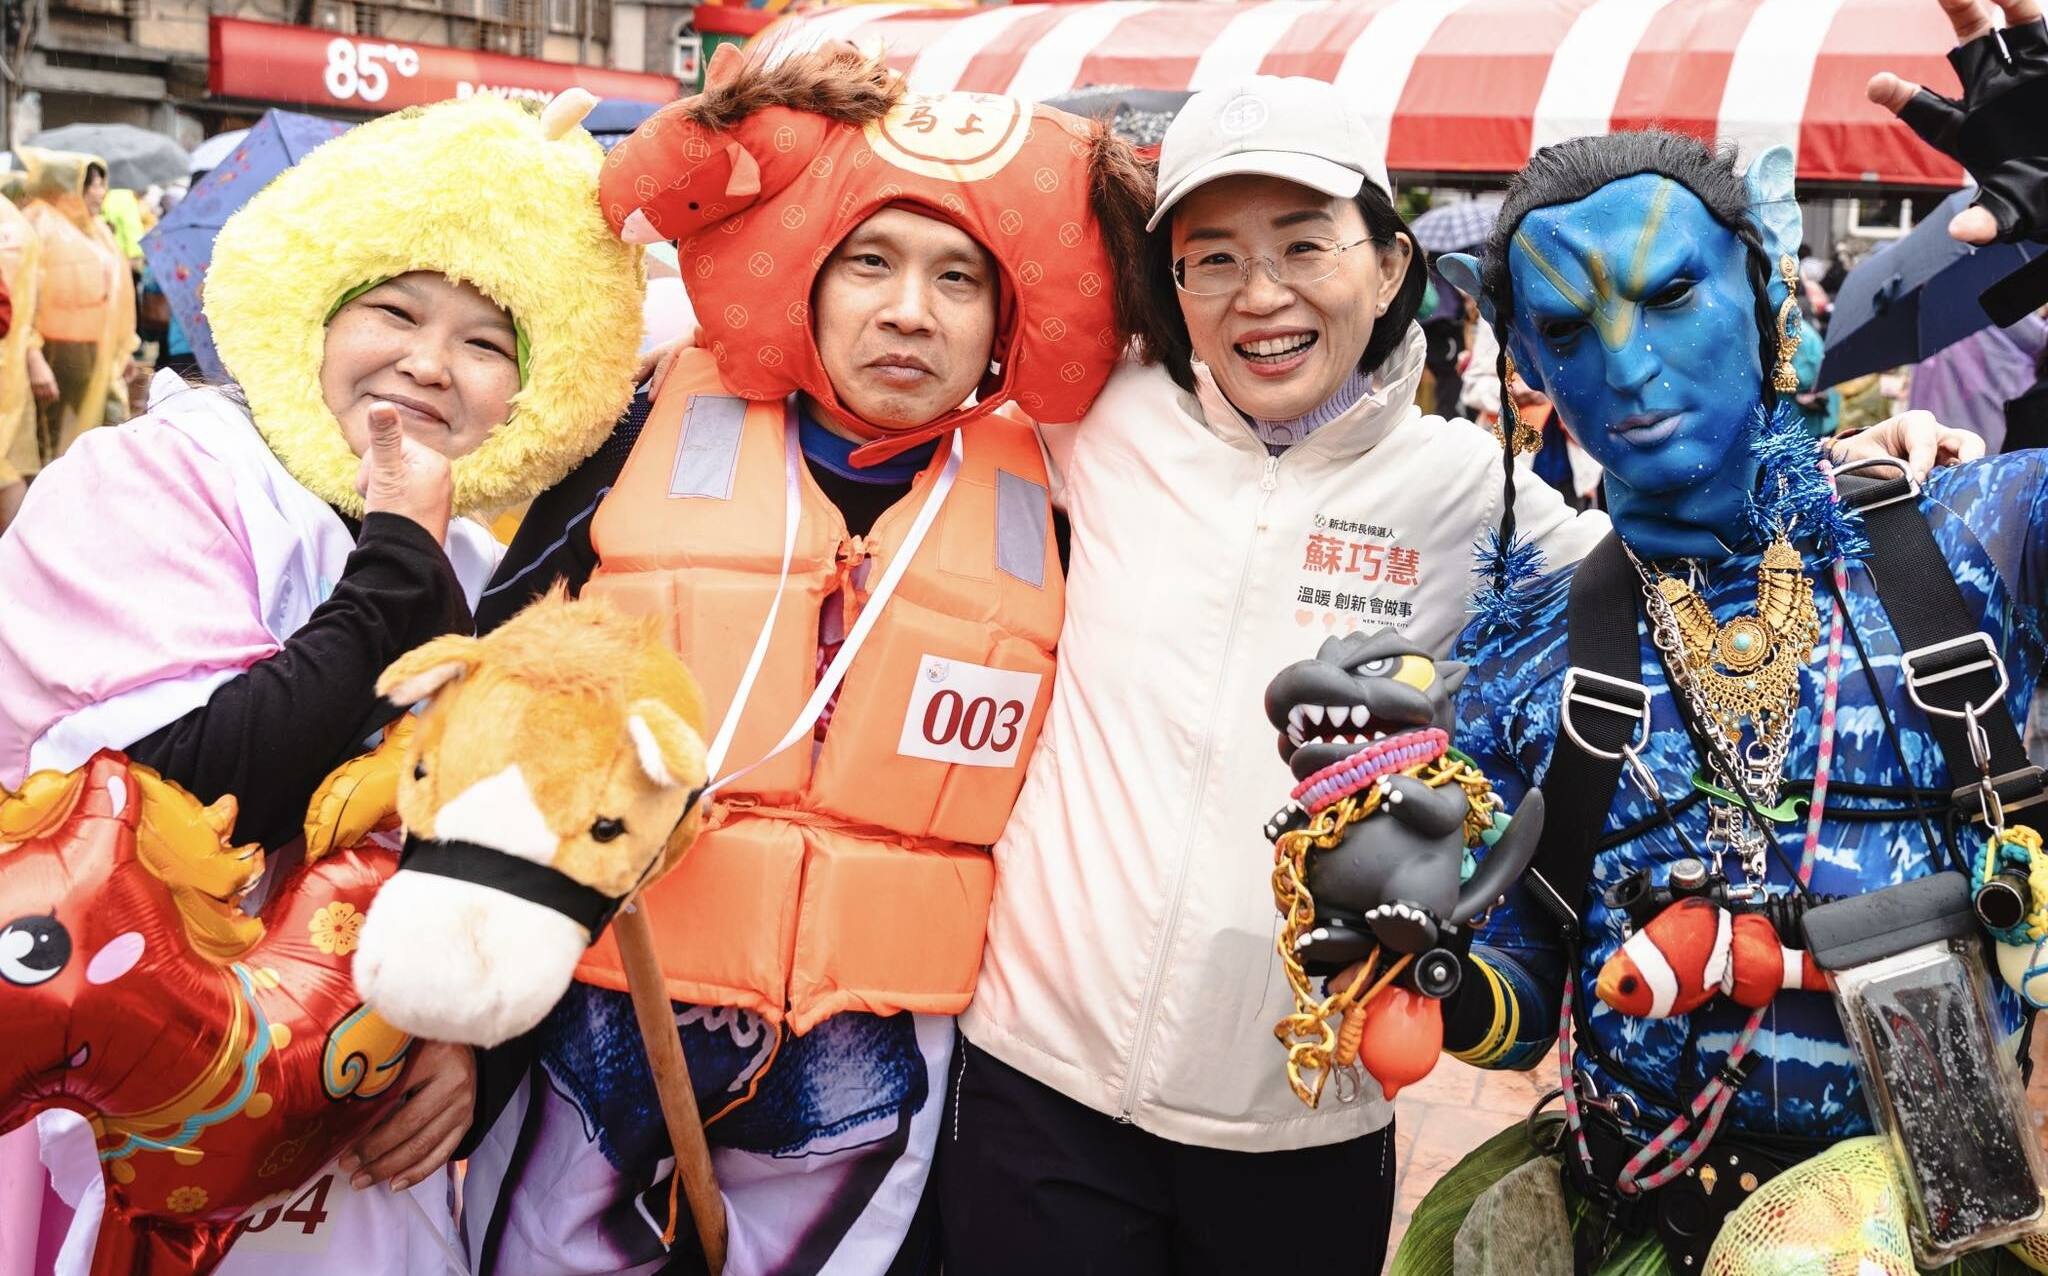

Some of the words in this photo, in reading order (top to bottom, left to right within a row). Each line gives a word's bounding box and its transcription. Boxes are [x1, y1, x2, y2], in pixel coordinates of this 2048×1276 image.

[1328, 518, 1395, 538] 新北市長候選人
[1302, 533, 1421, 586] 蘇巧慧
[1297, 585, 1332, 608] 溫暖
[1334, 592, 1367, 613] 創新
[1369, 597, 1413, 618] 會做事
[922, 689, 1024, 752] 003
